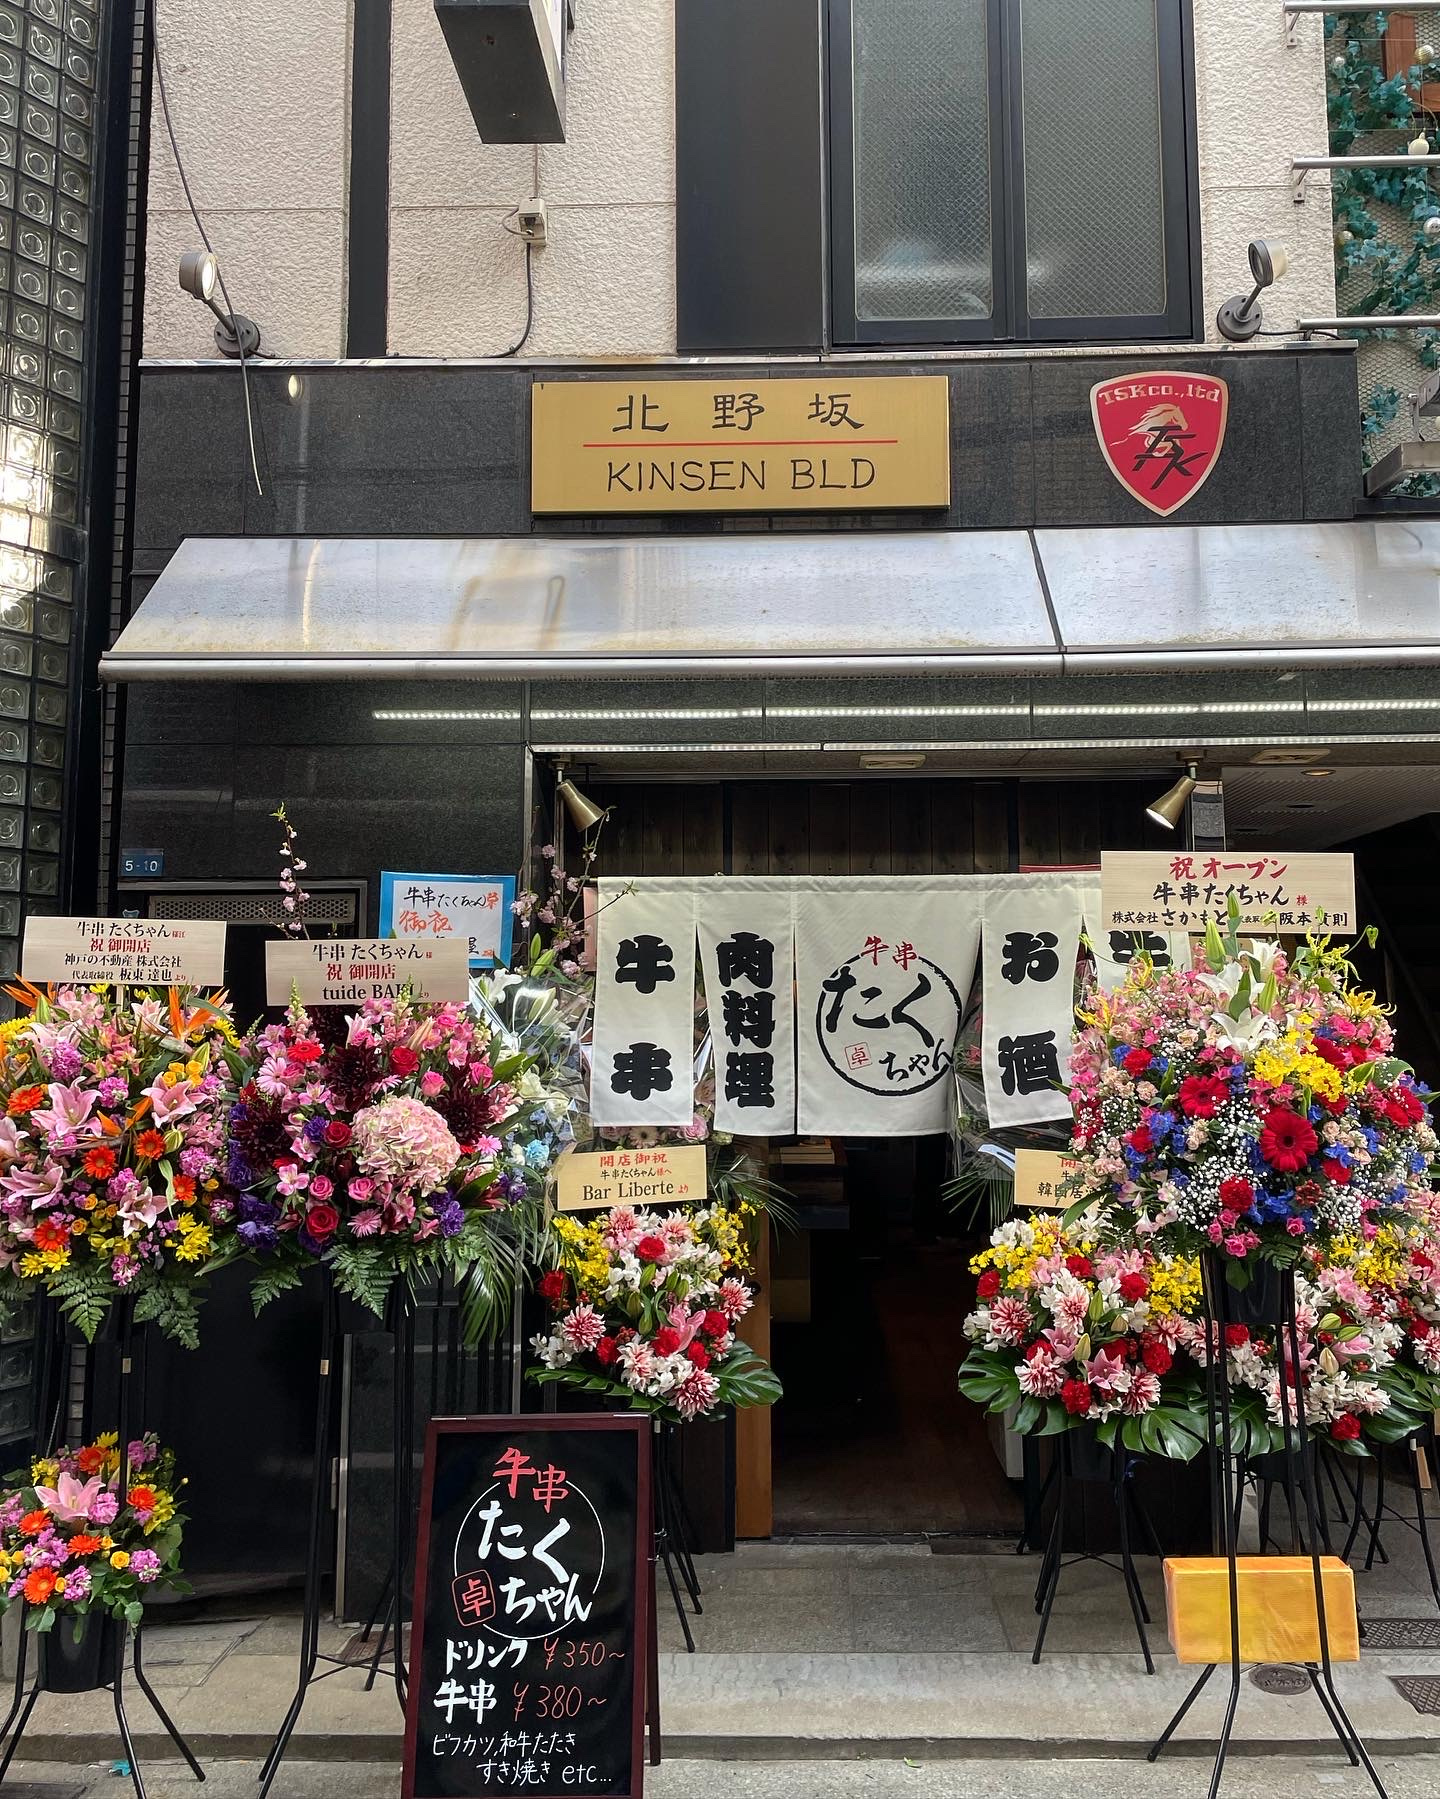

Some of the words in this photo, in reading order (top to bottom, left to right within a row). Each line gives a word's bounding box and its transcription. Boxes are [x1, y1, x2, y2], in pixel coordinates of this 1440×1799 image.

[606, 459, 766, 493] KINSEN
[791, 458, 876, 490] BLD
[125, 860, 158, 872] 5-10
[136, 955, 182, 968] 株式会社
[860, 935, 918, 971] 牛串
[322, 985, 367, 1000] tuide
[822, 965, 936, 1049] たく
[715, 931, 777, 1108] 肉料理
[878, 1038, 953, 1083] ちゃん
[600, 1152, 668, 1168] 開店御祝
[582, 1184, 612, 1201] Bar
[617, 1181, 674, 1198] Liberte
[492, 1447, 570, 1514] 牛串
[477, 1500, 571, 1584] たく
[499, 1573, 593, 1624] ちゃん
[445, 1638, 528, 1676] ドリンク
[433, 1679, 498, 1725] 牛串
[475, 1758, 552, 1787] すき焼き
